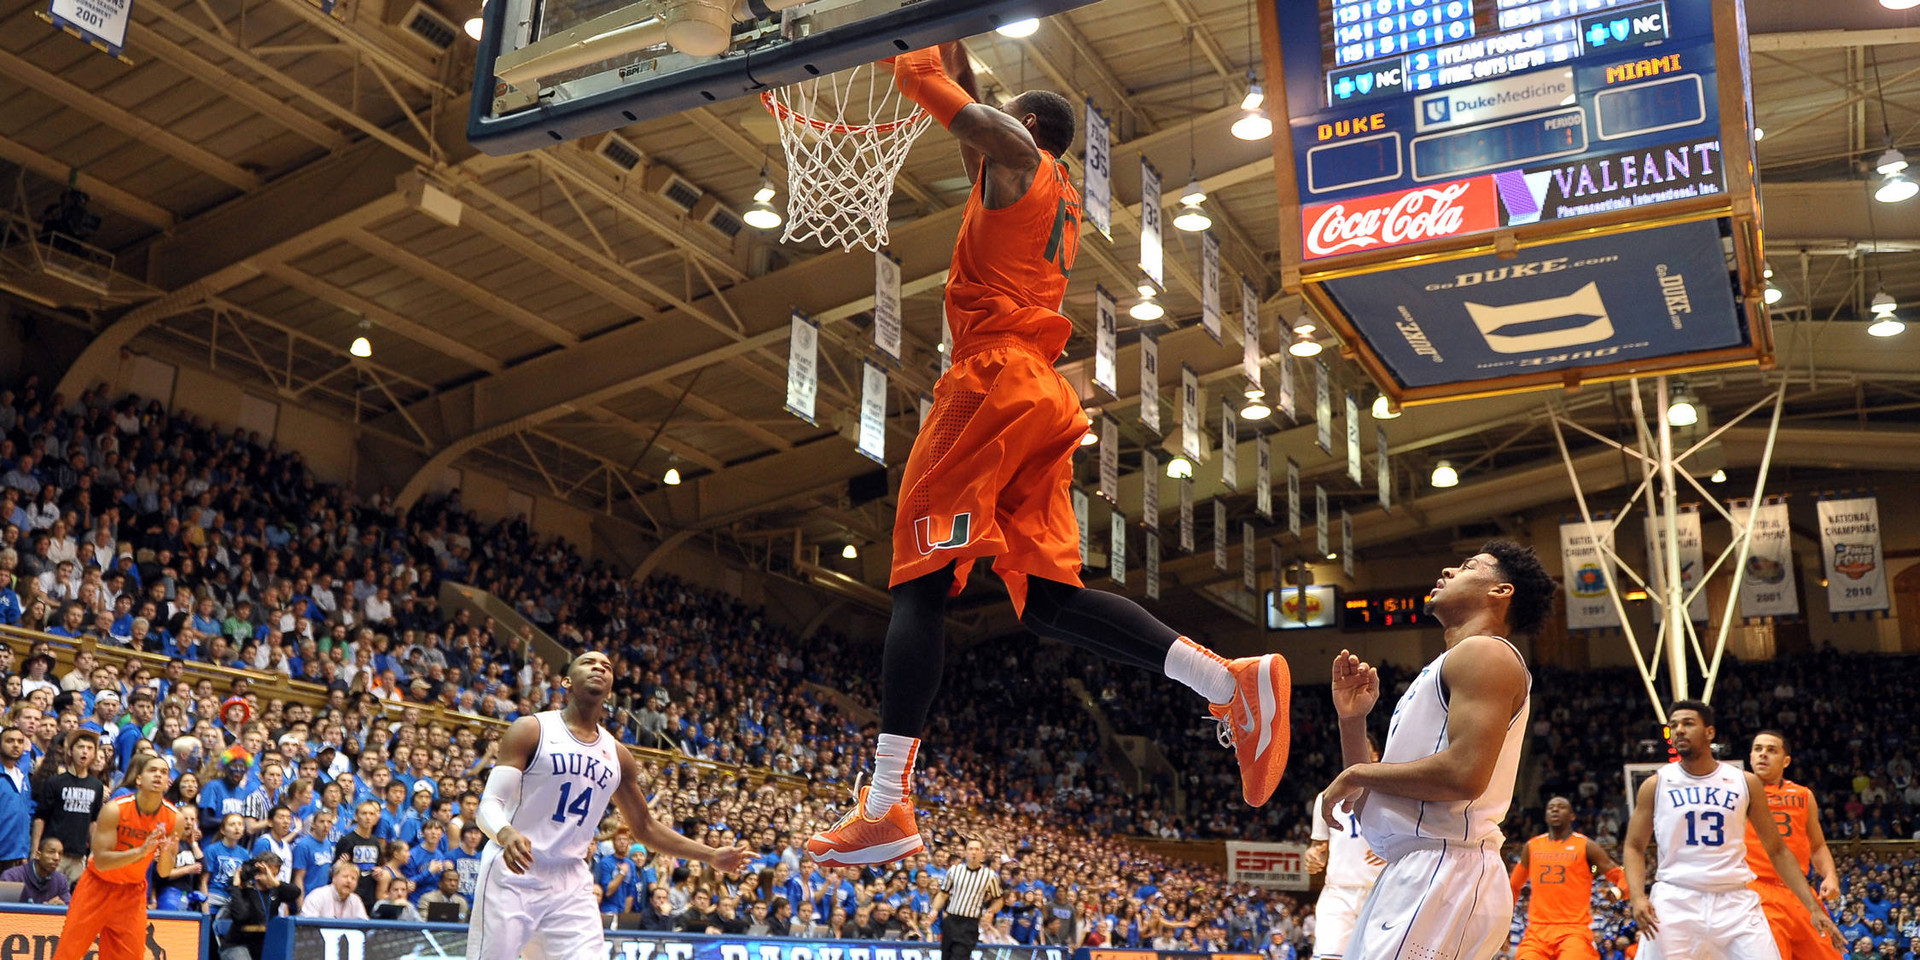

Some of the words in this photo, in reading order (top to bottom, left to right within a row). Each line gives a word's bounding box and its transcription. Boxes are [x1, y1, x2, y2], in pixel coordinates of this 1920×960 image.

[76, 6, 104, 29] 2001
[1340, 24, 1363, 44] 14
[1378, 17, 1394, 34] 0
[1412, 9, 1428, 26] 0
[1447, 1, 1463, 18] 0
[1633, 14, 1661, 35] NC
[1380, 36, 1395, 54] 5
[1416, 29, 1427, 46] 1
[1449, 21, 1465, 39] 0
[1376, 68, 1402, 89] NC
[1606, 53, 1682, 84] MIAMI
[1455, 82, 1566, 112] DukeMedicine
[1317, 112, 1386, 142] DUKE
[1544, 114, 1582, 131] PERIOD
[1565, 127, 1573, 145] 1
[1552, 141, 1716, 199] VALEANT
[1307, 182, 1470, 255] Coca-Cola
[1425, 255, 1619, 291] GoDUKE.com
[1655, 264, 1692, 330] GoDUKE.com
[1825, 523, 1877, 536] CHAMPIONS
[1828, 511, 1871, 523] NATIONAL
[914, 512, 971, 555] U
[1845, 587, 1873, 598] 2010
[550, 753, 613, 790] DUKE
[62, 786, 95, 802] CAMERON
[552, 782, 593, 827] 14
[1668, 786, 1739, 811] DUKE
[1685, 811, 1724, 847] 13
[1235, 850, 1301, 873] ESPN
[1539, 864, 1566, 884] 23
